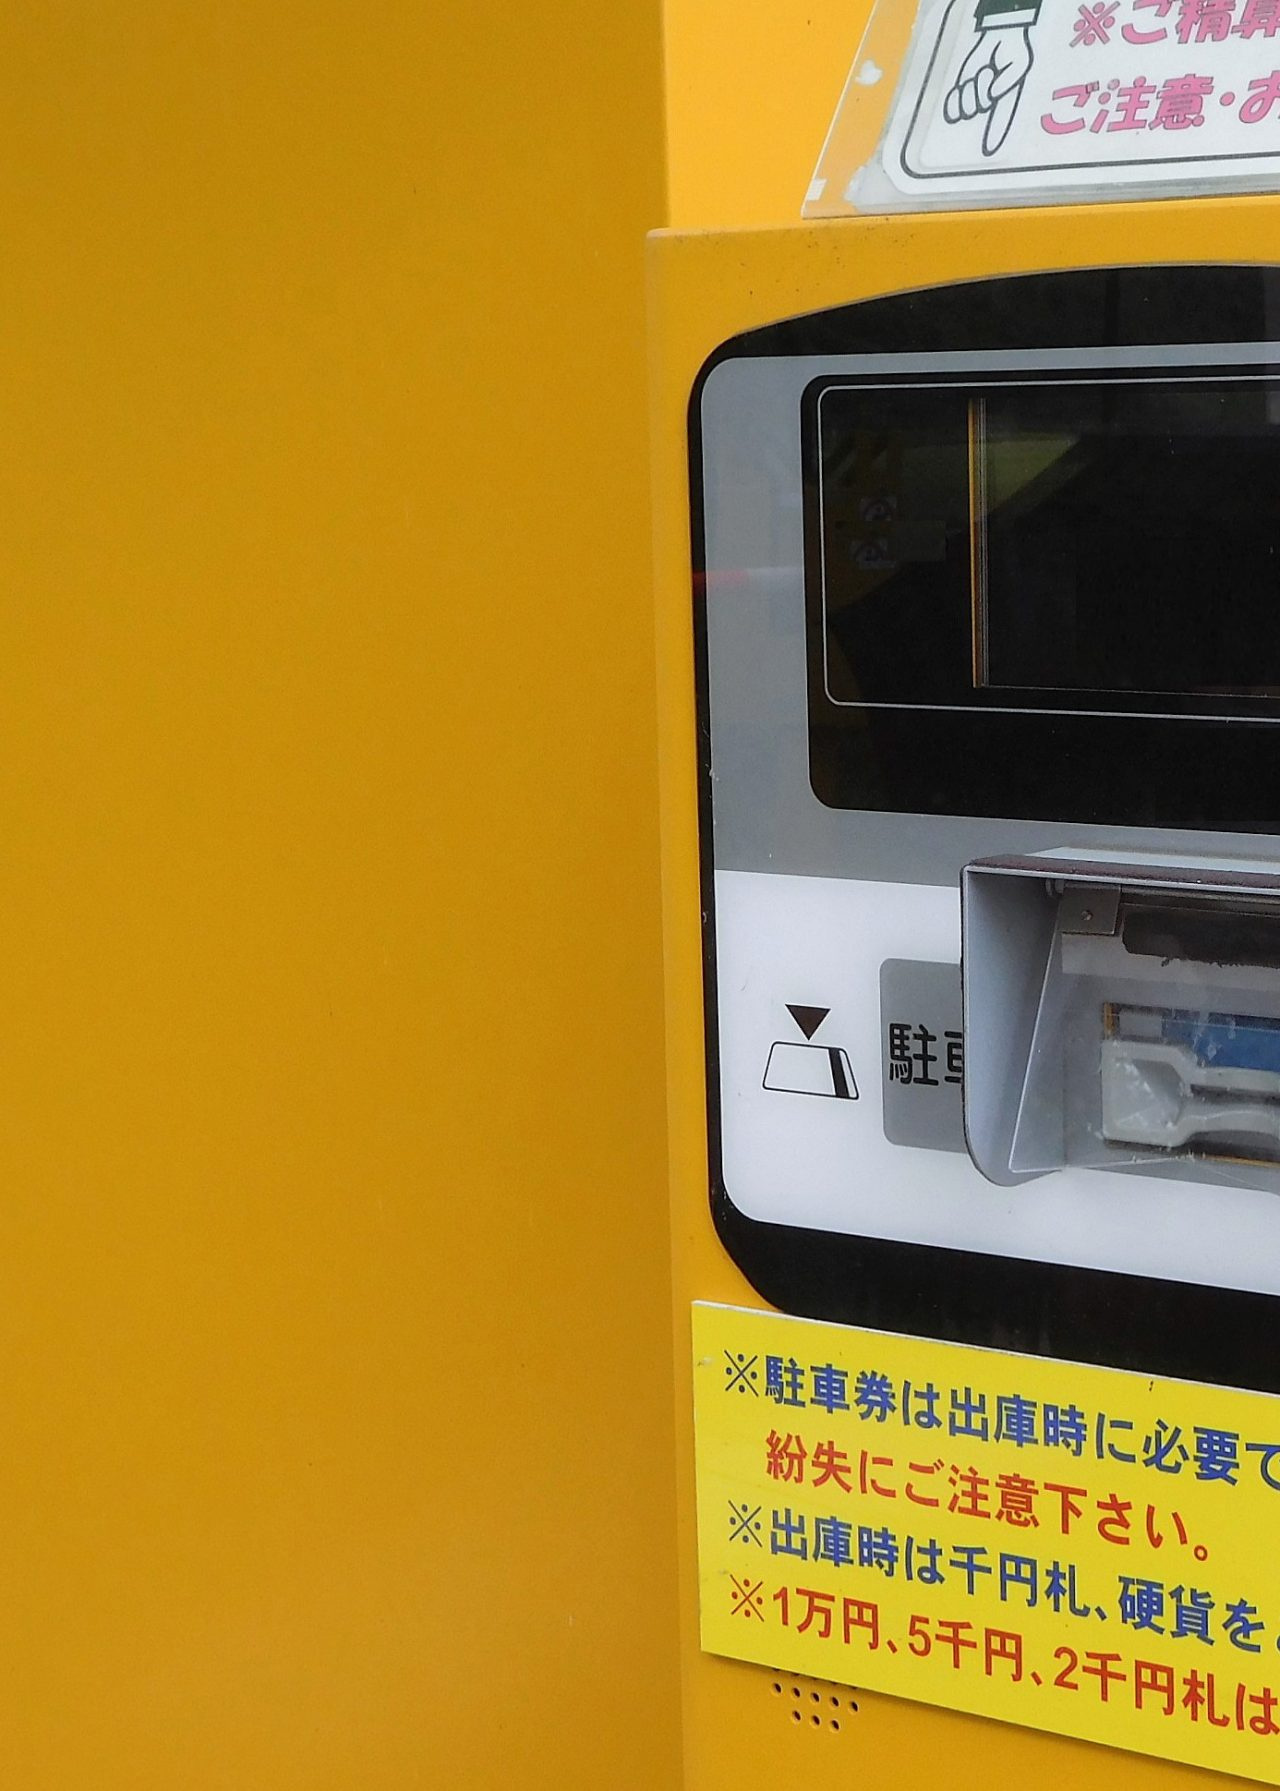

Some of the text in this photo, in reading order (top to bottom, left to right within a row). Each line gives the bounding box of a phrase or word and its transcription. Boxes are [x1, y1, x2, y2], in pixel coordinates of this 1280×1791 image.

[765, 1428, 1208, 1561] 紛失にご注意下さい。
